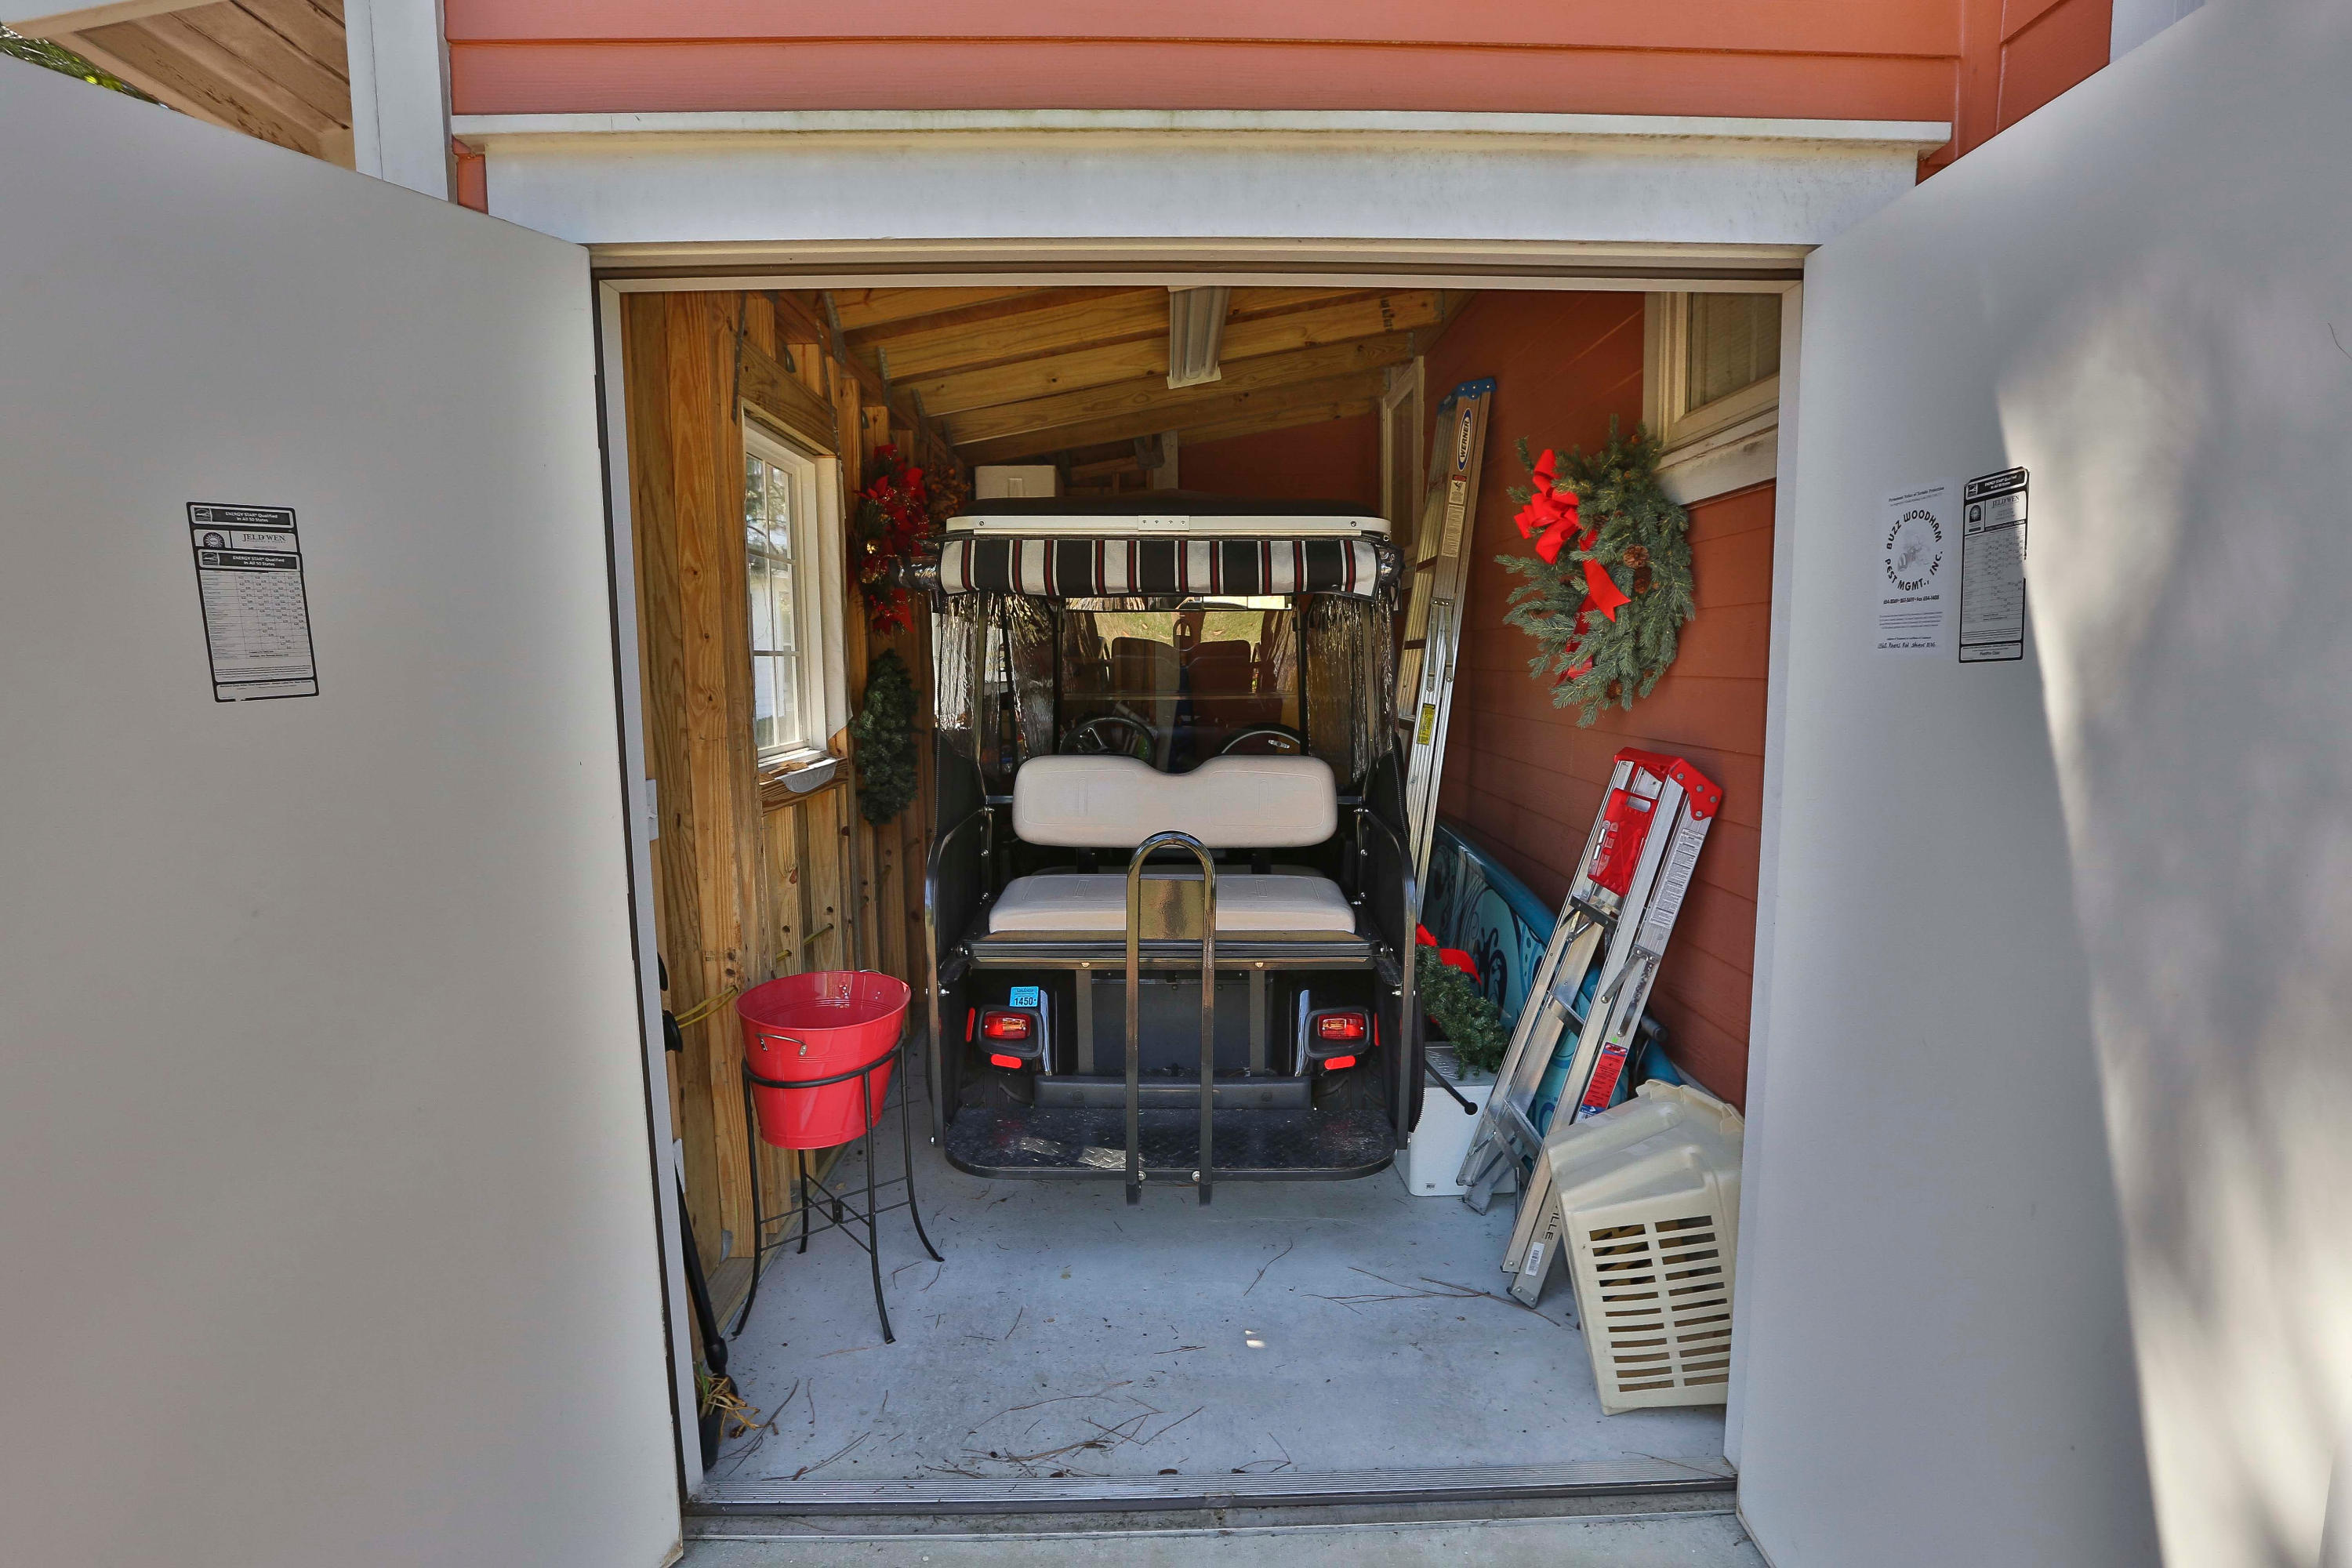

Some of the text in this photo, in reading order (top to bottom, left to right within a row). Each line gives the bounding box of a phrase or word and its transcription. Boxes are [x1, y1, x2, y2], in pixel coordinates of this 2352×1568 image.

[1460, 419, 1470, 459] WERNER
[1886, 509, 1942, 550] BUZZ WOODHAM
[1885, 558, 1898, 584] PEST
[1929, 550, 1944, 576] INC.
[1014, 996, 1033, 1006] 1450
[1544, 1205, 1560, 1240] ILLE
